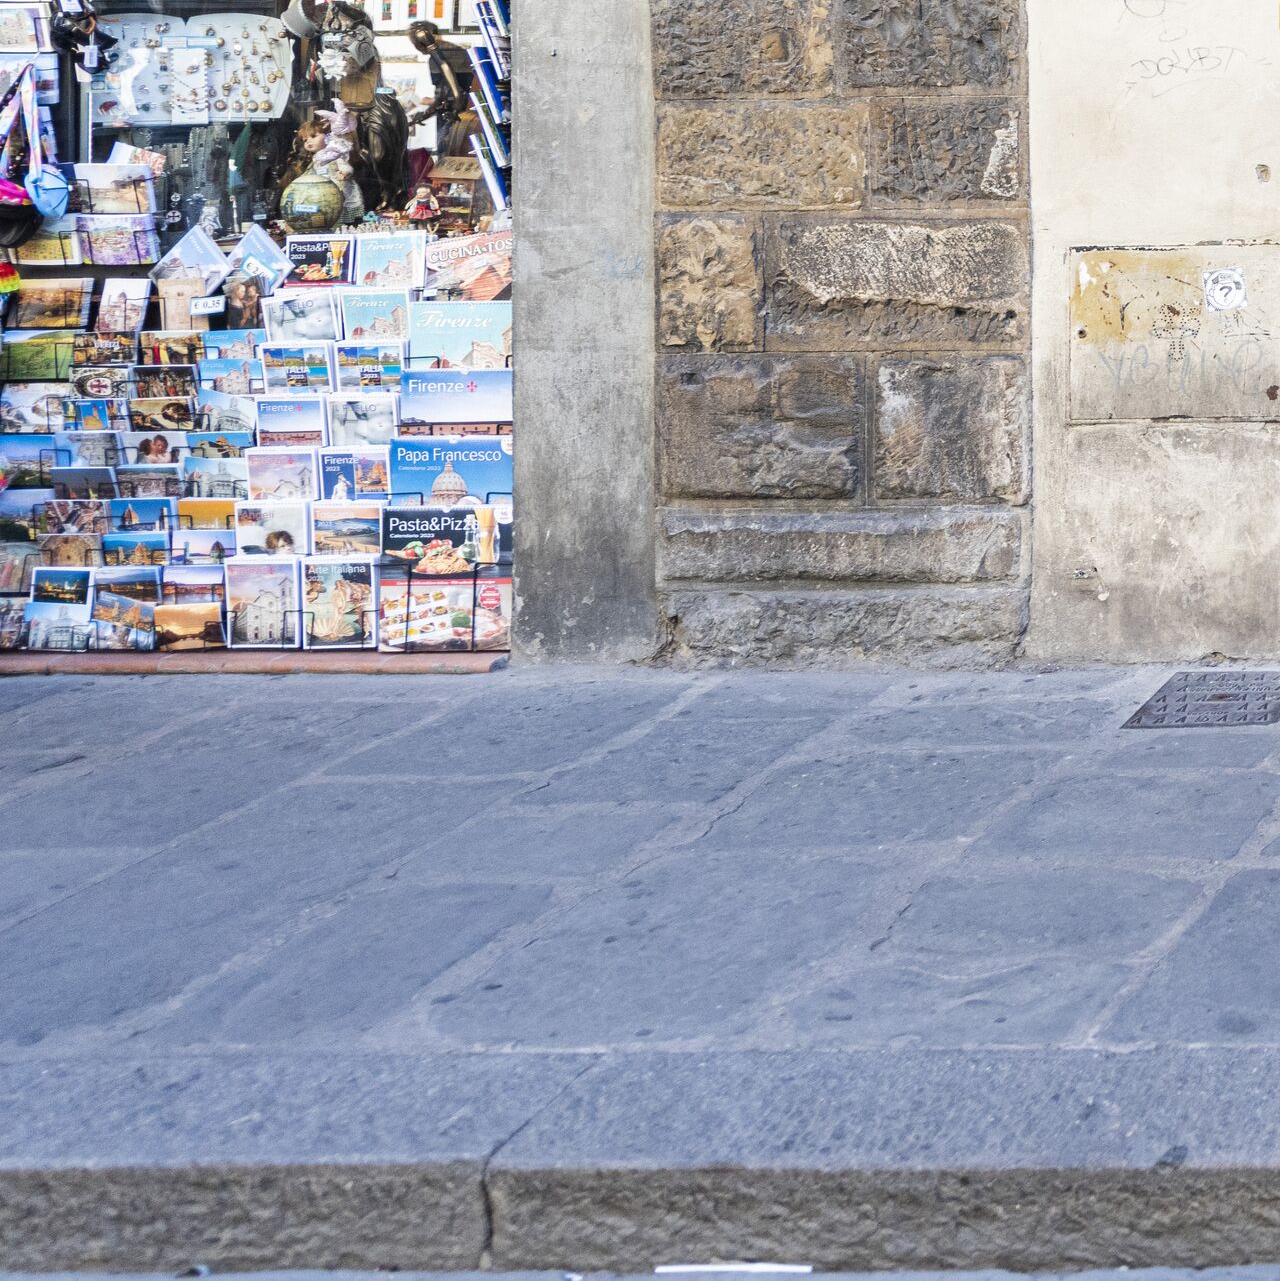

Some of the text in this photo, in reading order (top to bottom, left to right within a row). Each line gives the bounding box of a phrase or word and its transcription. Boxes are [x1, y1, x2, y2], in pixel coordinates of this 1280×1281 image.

[429, 245, 482, 263] CUCINA
[416, 310, 493, 328] Firenze
[408, 379, 465, 393] Firenze
[260, 403, 294, 412] Firenze
[324, 455, 360, 465] Firenze
[397, 447, 502, 464] Papa Francesco
[308, 564, 366, 574] Arte Italiana
